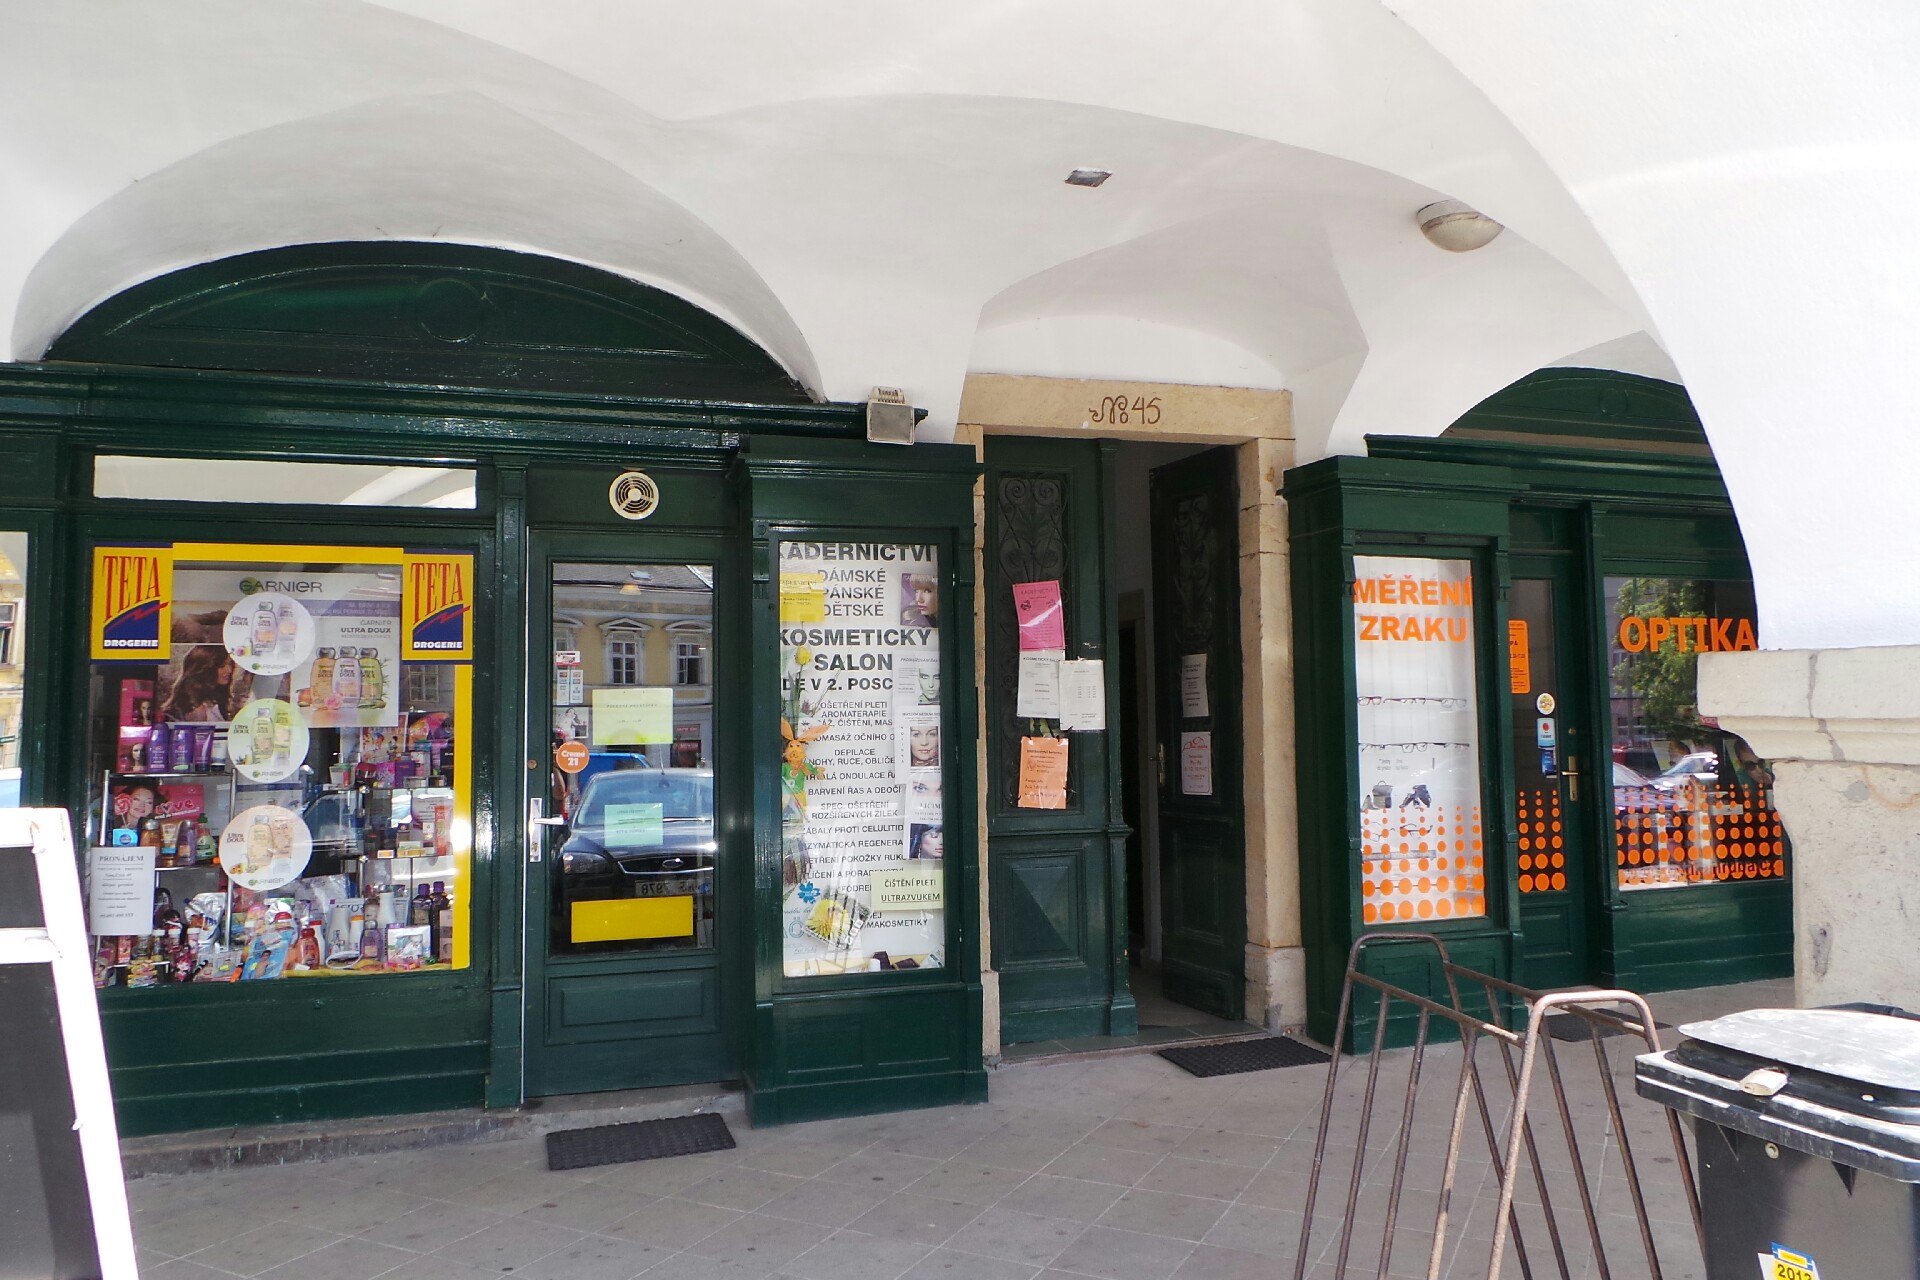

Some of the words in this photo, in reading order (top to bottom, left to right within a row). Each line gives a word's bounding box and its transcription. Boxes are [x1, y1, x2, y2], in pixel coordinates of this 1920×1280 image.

[1131, 396, 1162, 425] 45
[102, 556, 160, 621] TETA
[1353, 574, 1473, 607] MĚŘENÍ
[411, 563, 463, 625] TETA
[1359, 615, 1468, 642] ZRAKU
[1619, 616, 1758, 654] OPTIKA
[103, 639, 159, 647] DROGERIE
[413, 641, 463, 649] DROGERIE
[814, 653, 893, 671] SALON
[811, 678, 822, 691] V
[827, 678, 843, 691] 2.
[820, 700, 863, 709] OŠETŘENÍ
[864, 701, 888, 709] PLETI
[853, 732, 887, 741] OČNÍHO
[568, 758, 579, 766] 21
[837, 758, 863, 766] RUCE,
[808, 786, 845, 796] BARVENÍ
[847, 786, 864, 795] ŘAS
[820, 802, 844, 810] SPEC.
[847, 800, 889, 809] OŠETŘENÍ
[841, 854, 882, 863] POKOŽKY
[884, 877, 914, 888] ČIŠTĚNÍ
[916, 878, 937, 887] PLETI
[881, 893, 941, 902] ULTRAZVUKEM
